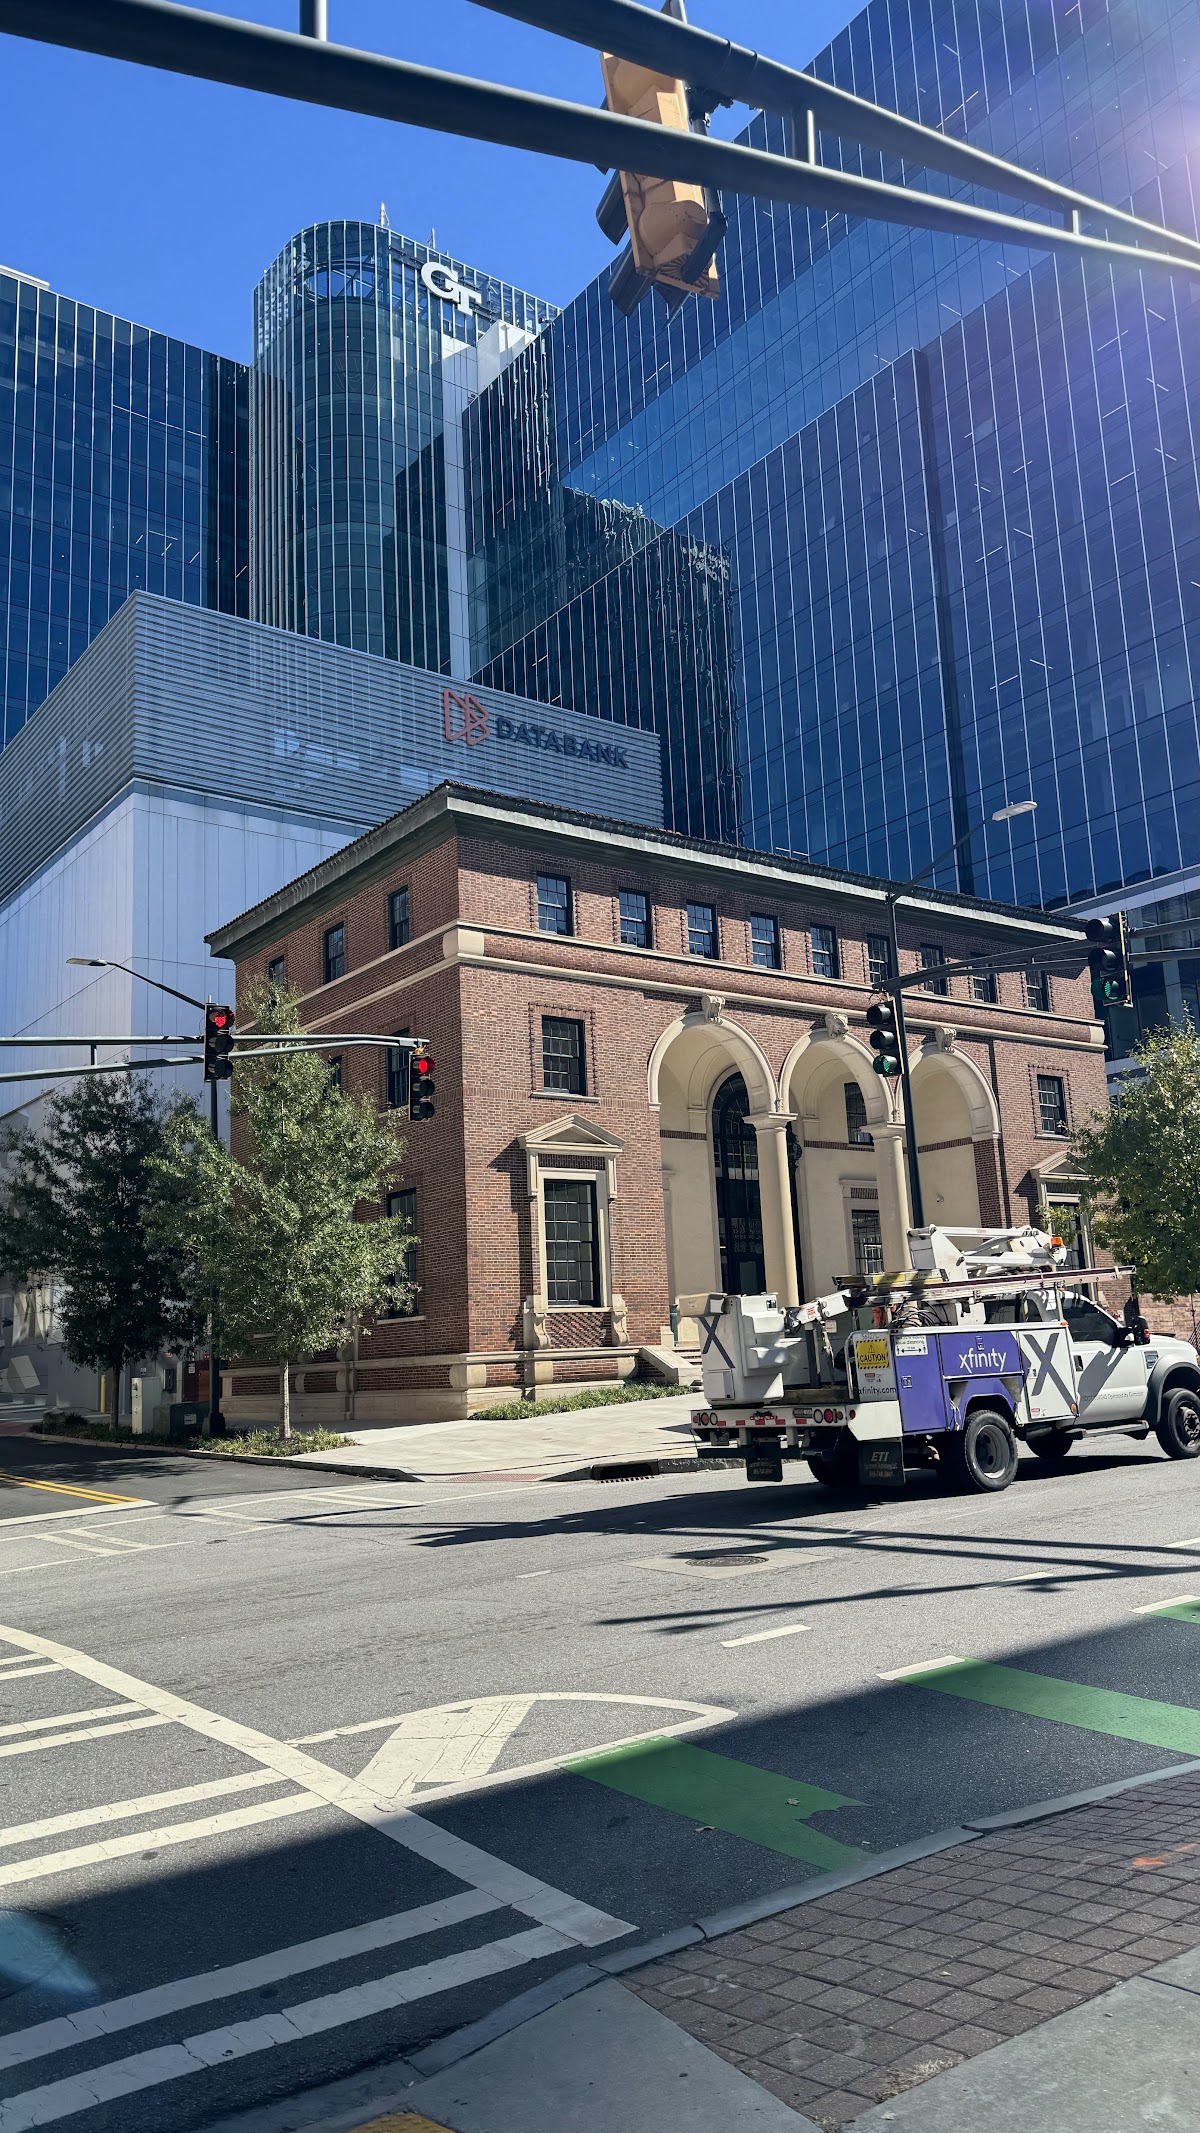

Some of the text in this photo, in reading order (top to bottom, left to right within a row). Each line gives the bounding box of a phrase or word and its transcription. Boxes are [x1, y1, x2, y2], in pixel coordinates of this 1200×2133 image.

[421, 262, 482, 316] GT
[496, 717, 630, 769] DATABANK
[859, 1353, 886, 1363] CAUTION
[959, 1347, 1007, 1374] xfinity
[870, 1451, 890, 1462] ETI
